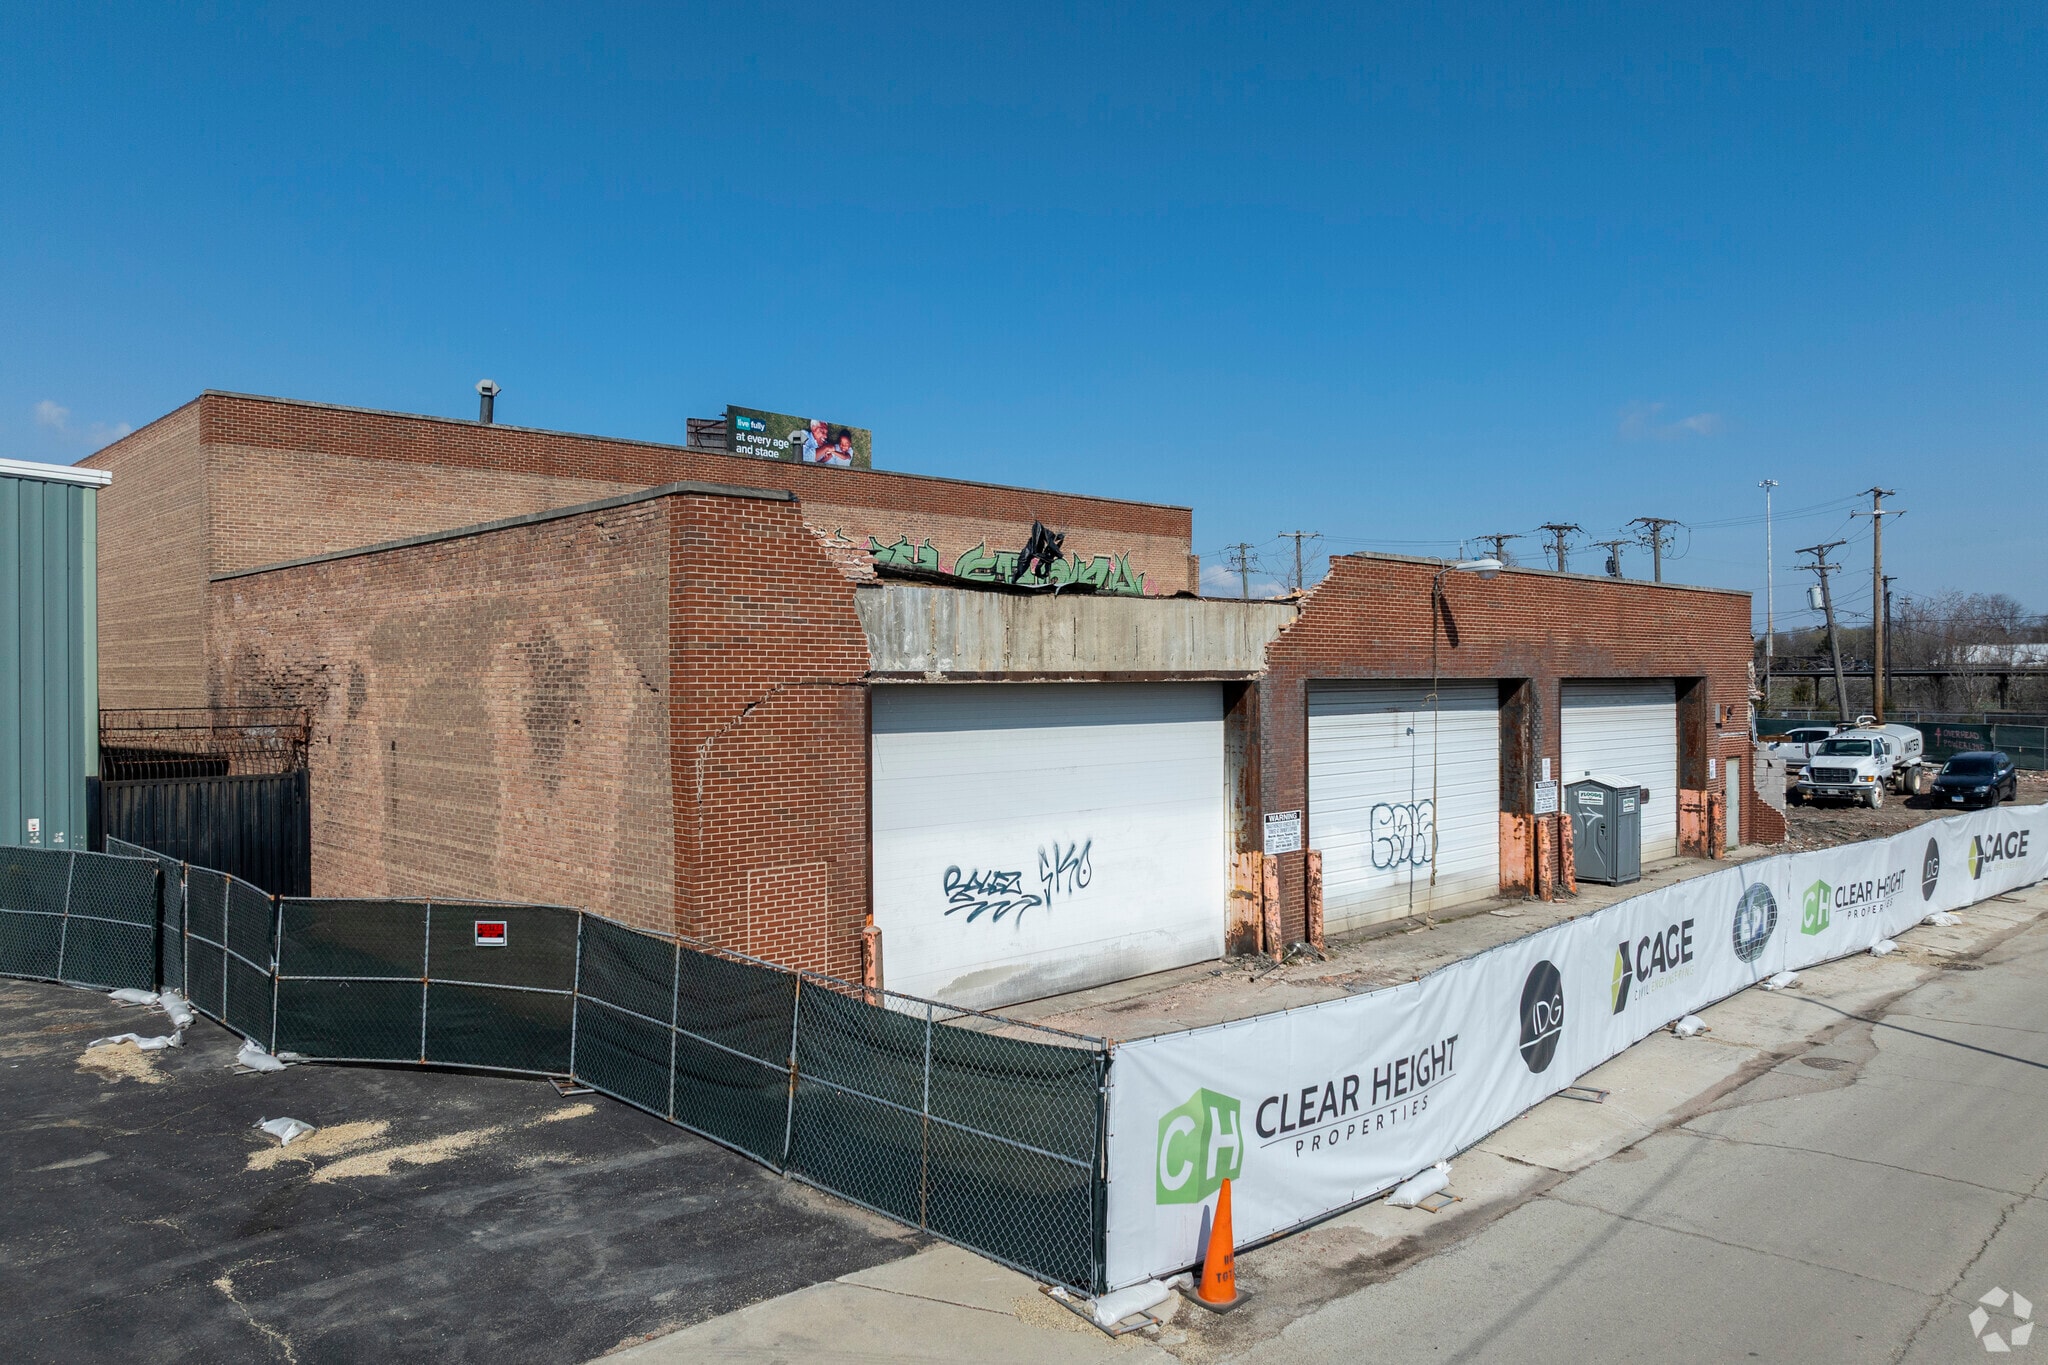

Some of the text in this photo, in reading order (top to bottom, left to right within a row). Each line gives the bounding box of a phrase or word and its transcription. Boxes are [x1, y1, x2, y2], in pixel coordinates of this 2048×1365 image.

[737, 418, 765, 431] live fully
[736, 432, 790, 450] at every age
[736, 445, 753, 455] and
[1904, 738, 1919, 754] WATER
[1268, 812, 1297, 822] WARNING
[1985, 829, 2030, 863] CAGE
[1926, 857, 1939, 878] DG
[1835, 880, 1873, 909] CLEAR
[1636, 917, 1694, 983] CAGE
[1532, 994, 1562, 1036] IDG
[1160, 1034, 1459, 1191] CH CLEAR HEIGHT
[1296, 1095, 1429, 1158] PROPERTIES
